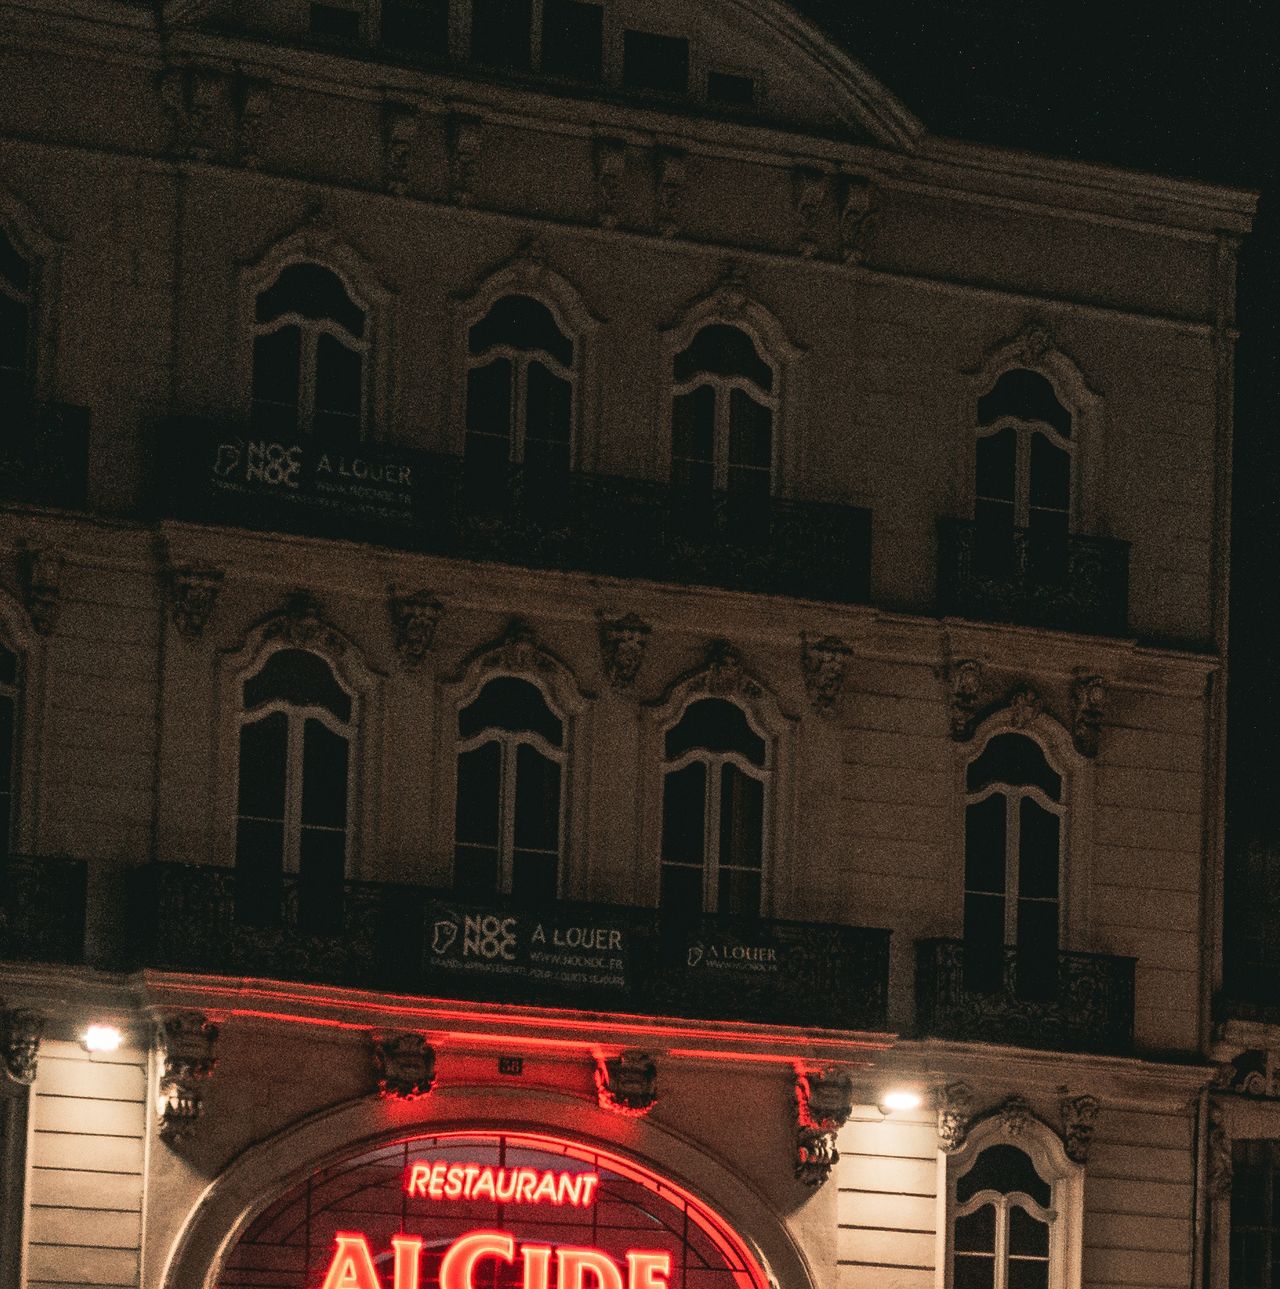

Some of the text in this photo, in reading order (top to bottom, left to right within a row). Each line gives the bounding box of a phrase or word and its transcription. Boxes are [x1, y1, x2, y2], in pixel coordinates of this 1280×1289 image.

[248, 440, 302, 467] NOC
[246, 462, 299, 489] NOC
[339, 456, 411, 485] LOUER
[464, 914, 517, 941] NOC
[553, 927, 623, 950] LOUER
[463, 936, 516, 960] NOC
[723, 944, 776, 961] LOUER
[409, 1163, 598, 1207] RESTAURANT
